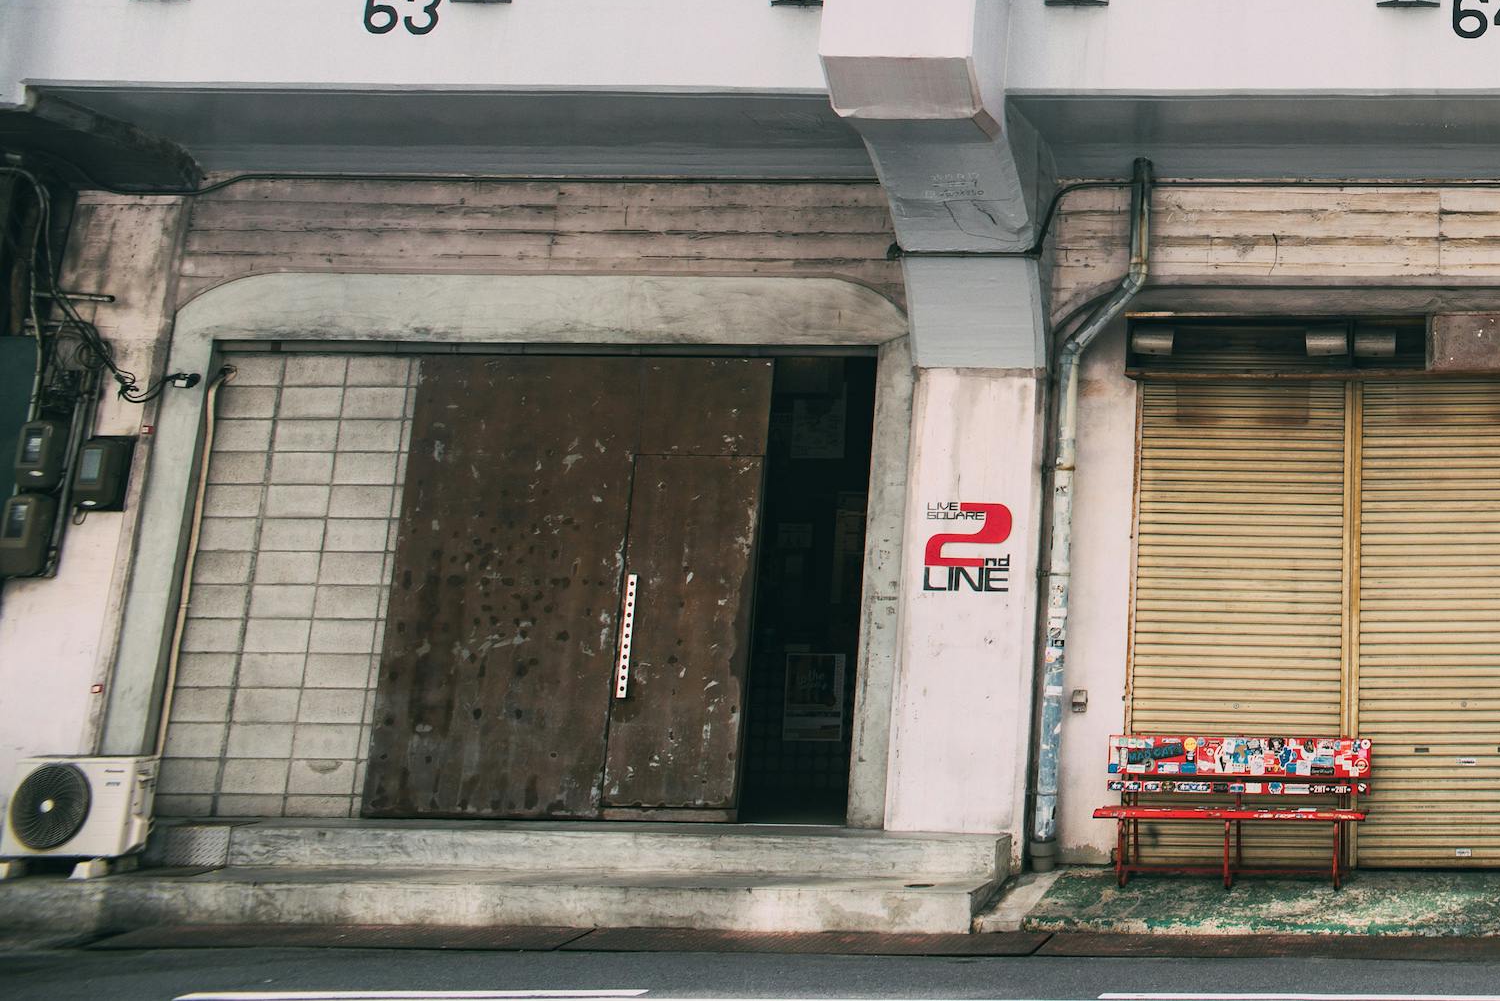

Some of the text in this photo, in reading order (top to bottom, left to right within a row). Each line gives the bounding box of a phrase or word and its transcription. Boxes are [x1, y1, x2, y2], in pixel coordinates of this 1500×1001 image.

[927, 502, 958, 511] LIVE
[926, 511, 985, 520] SQUARE
[923, 566, 1009, 592] LINE
